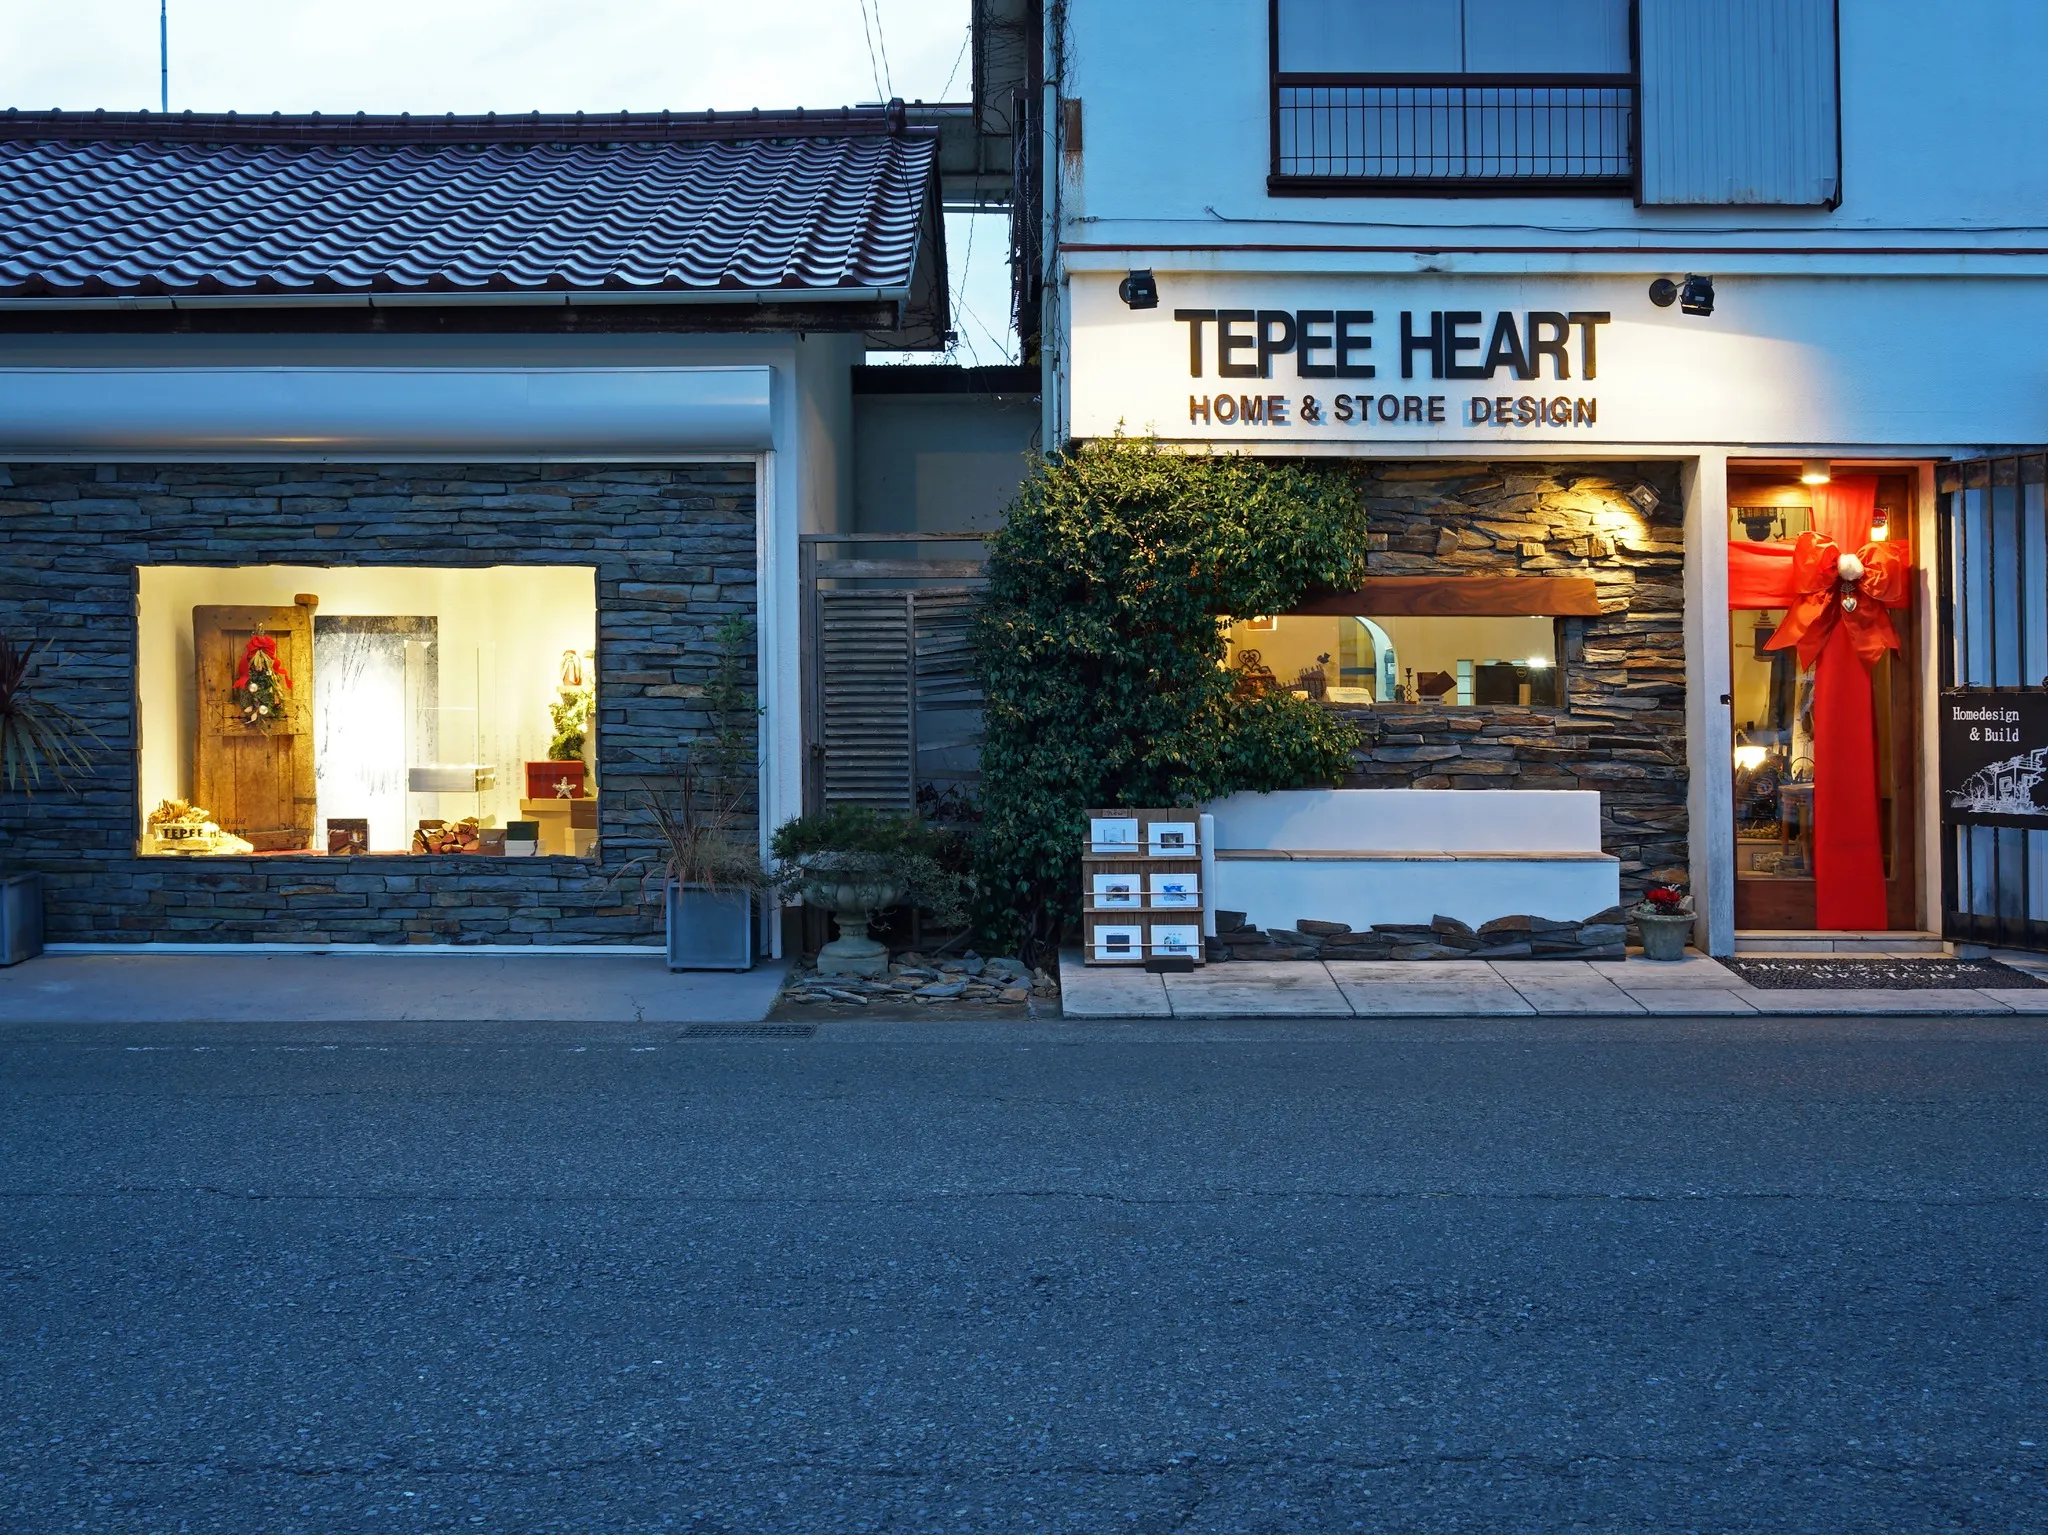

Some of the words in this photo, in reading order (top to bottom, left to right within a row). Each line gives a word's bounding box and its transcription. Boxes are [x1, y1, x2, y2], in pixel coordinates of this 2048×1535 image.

[1174, 309, 1376, 379] TEPEE
[1400, 310, 1611, 380] HEART
[1189, 395, 1285, 422] HOME
[1300, 395, 1320, 422] &
[1334, 395, 1446, 422] STORE
[1471, 396, 1597, 423] DESIGN
[1952, 706, 2020, 723] Homedesign
[1969, 727, 1981, 741] &
[1984, 727, 2020, 742] Build
